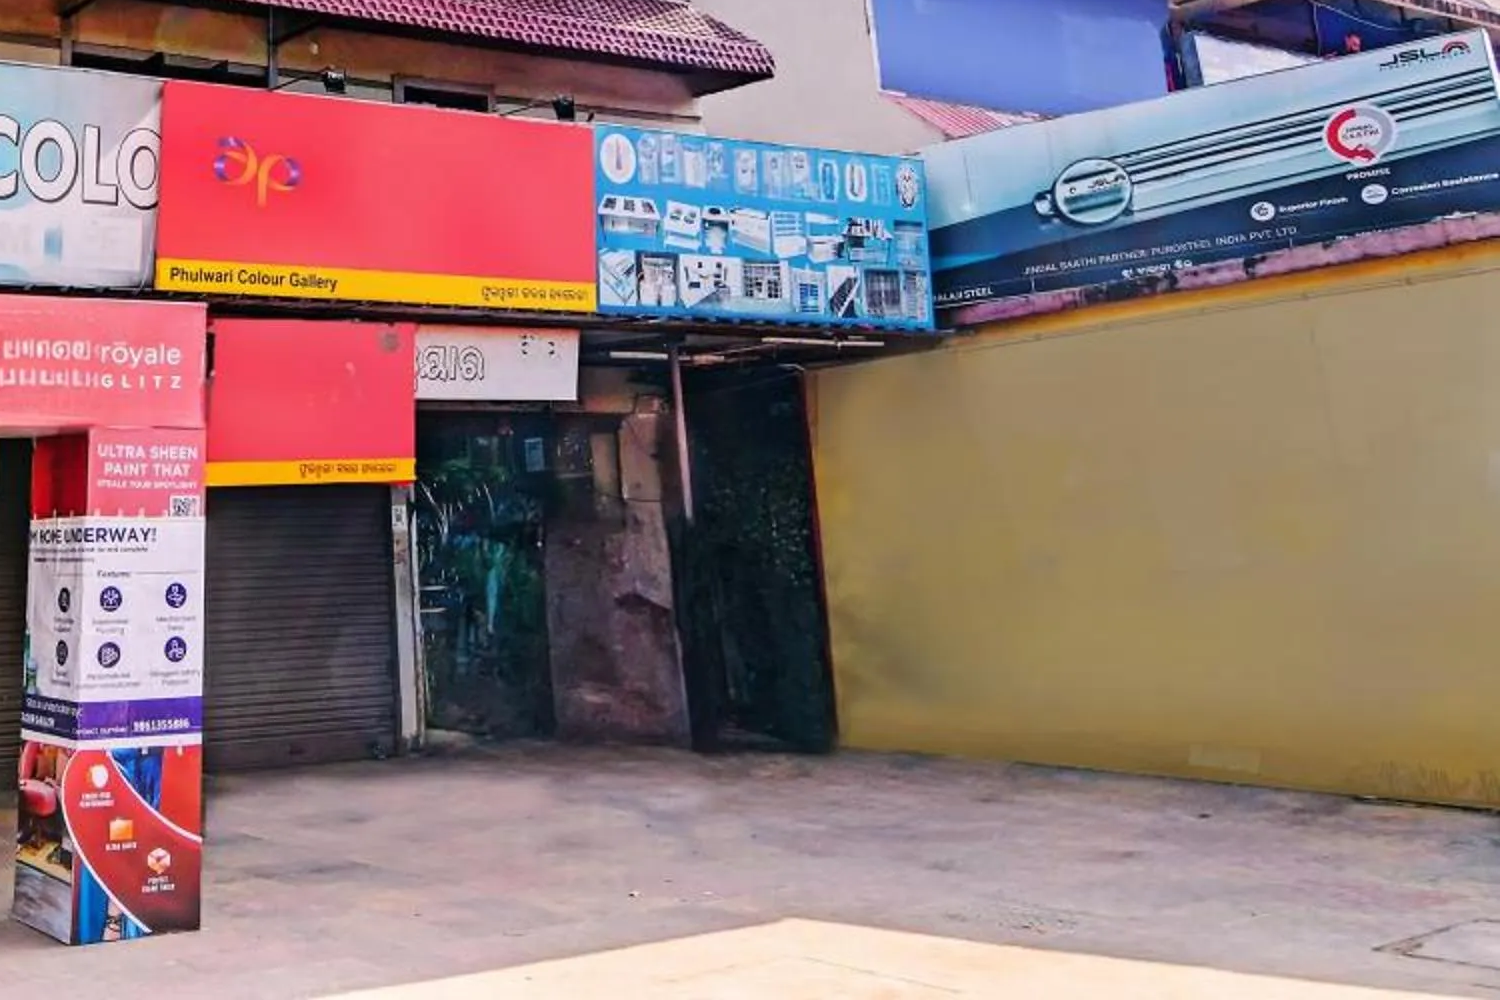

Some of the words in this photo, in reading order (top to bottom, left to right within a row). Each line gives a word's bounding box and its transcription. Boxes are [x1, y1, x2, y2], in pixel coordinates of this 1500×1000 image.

[1215, 234, 1248, 246] INDIA
[170, 267, 233, 284] Phulwari
[237, 269, 285, 286] Colour
[289, 273, 338, 293] Gallery
[101, 374, 181, 389] GLITZ
[97, 444, 146, 459] ULTRA
[150, 445, 198, 460] SHEEN
[104, 462, 147, 476] PAINT
[152, 463, 191, 477] THAT
